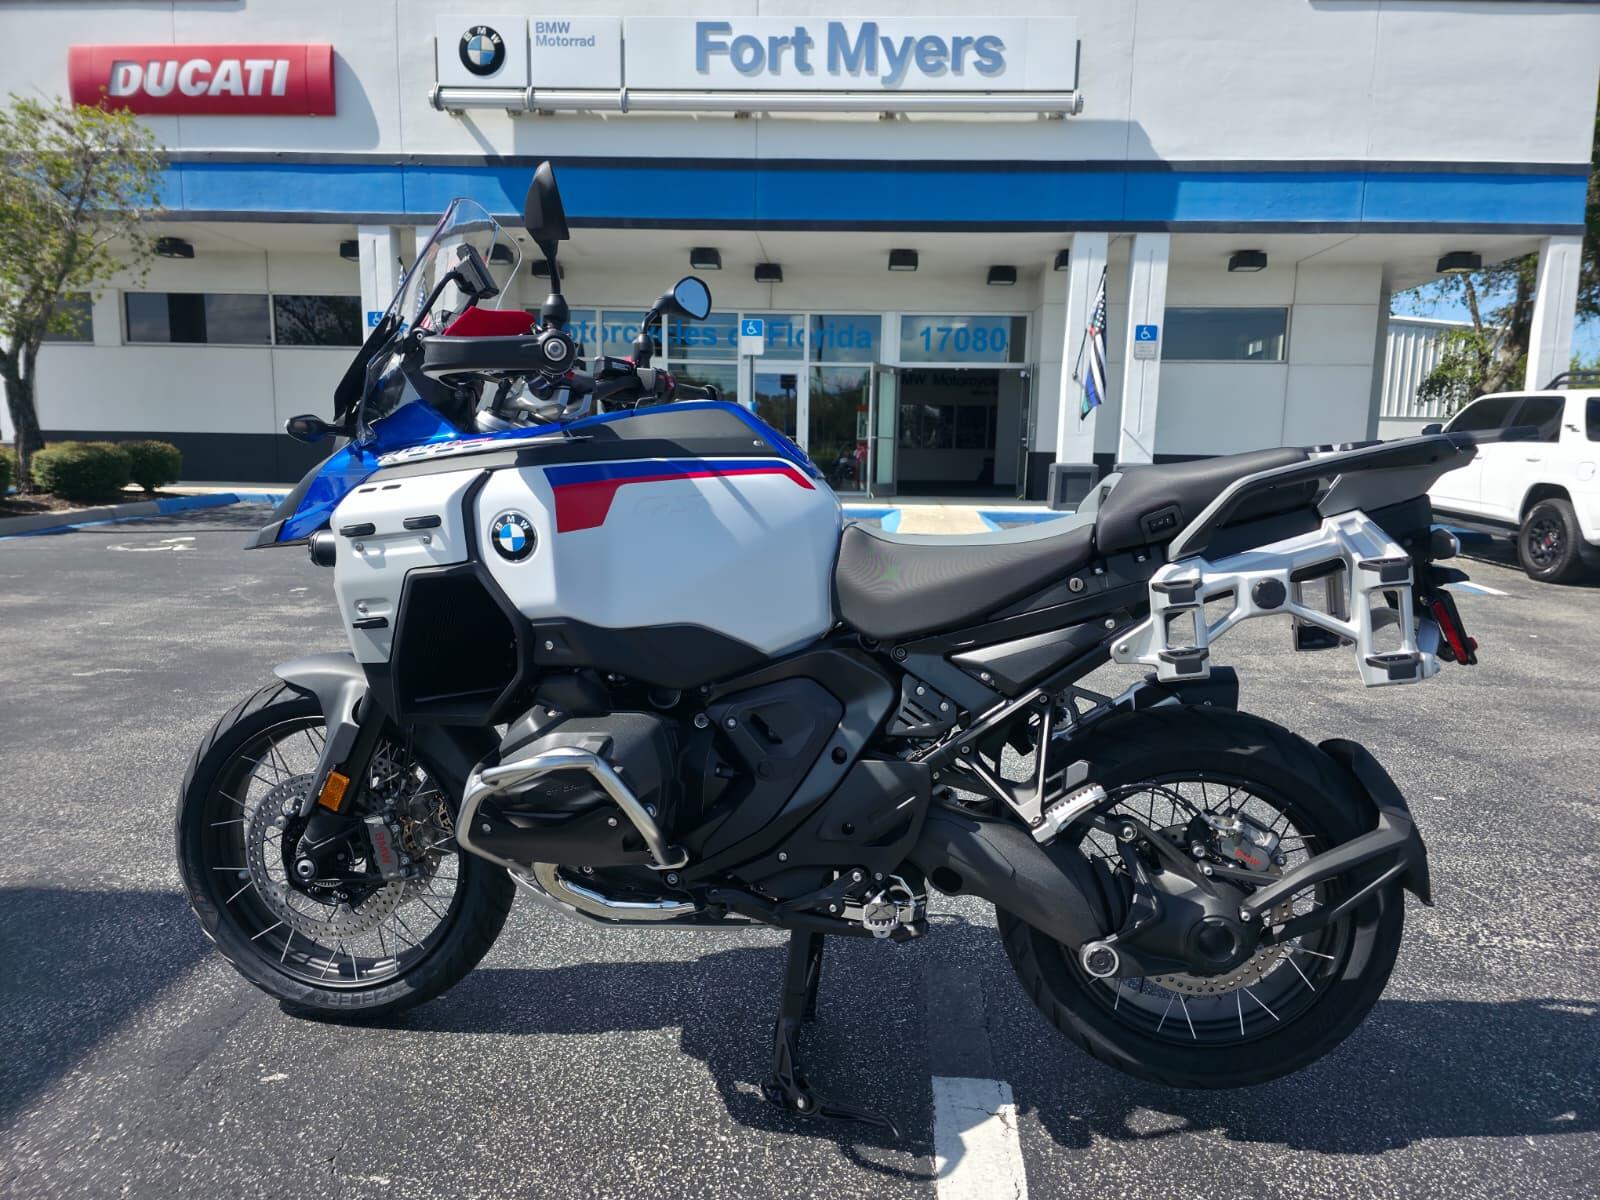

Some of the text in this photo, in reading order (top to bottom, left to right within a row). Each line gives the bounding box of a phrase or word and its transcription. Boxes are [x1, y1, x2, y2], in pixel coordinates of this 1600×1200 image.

[463, 26, 501, 44] BMW
[535, 21, 571, 34] BMW
[535, 35, 596, 47] Motorrad
[696, 21, 1005, 87] Fort Myers
[108, 58, 290, 97] DUCATI
[562, 319, 718, 347] otorccles
[767, 321, 873, 349] Florida
[919, 326, 1008, 352] 17080
[495, 515, 530, 531] BMW
